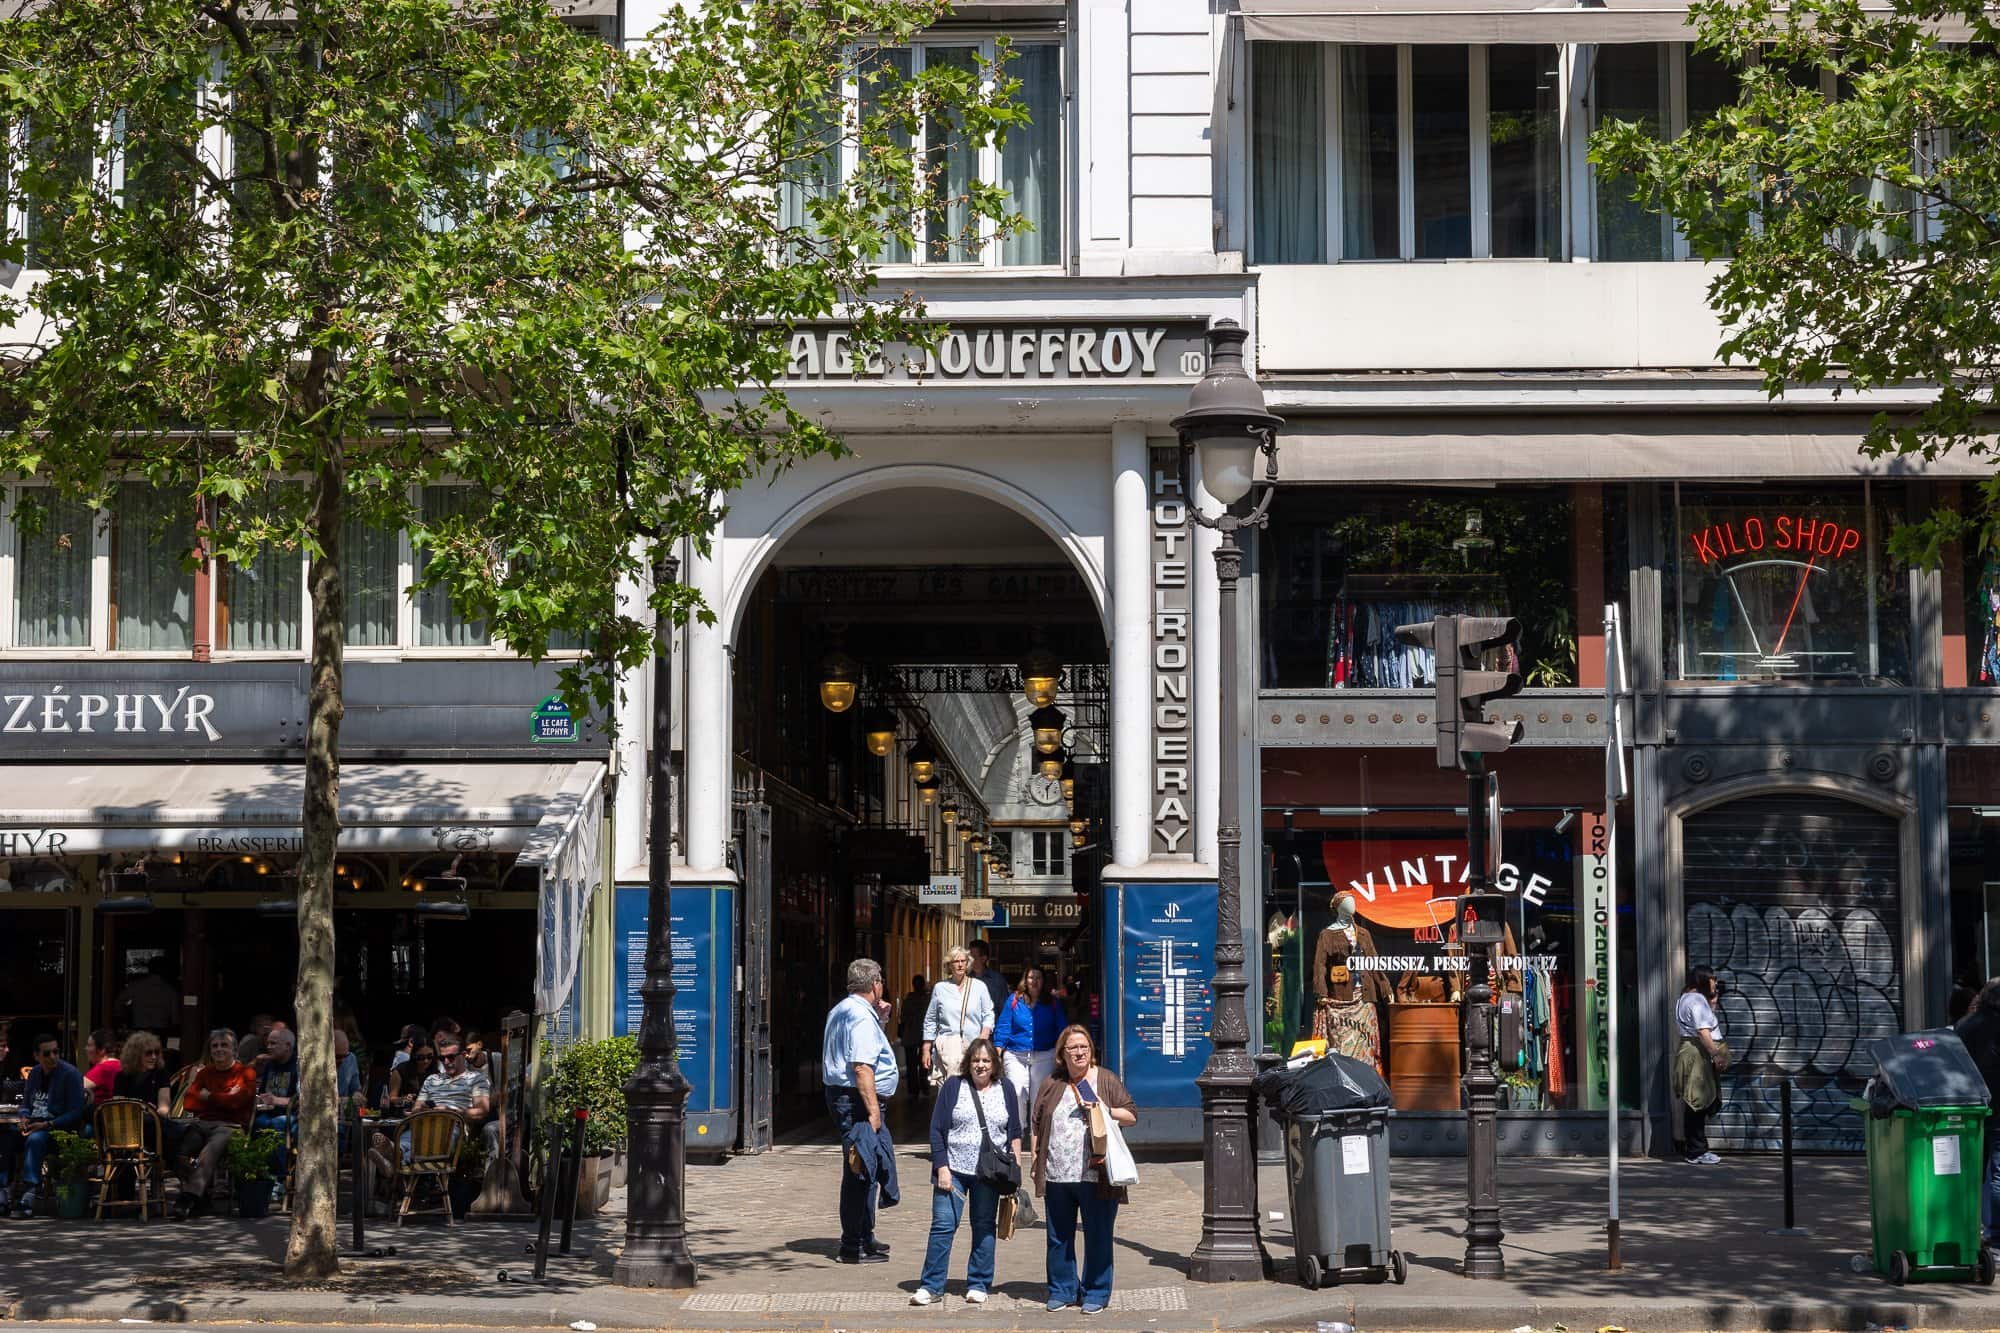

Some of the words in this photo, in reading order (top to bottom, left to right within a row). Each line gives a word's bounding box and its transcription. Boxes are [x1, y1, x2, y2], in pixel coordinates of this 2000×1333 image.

[1185, 355, 1200, 373] 10
[1155, 470, 1186, 614] HOTEL
[1691, 516, 1765, 565] KILO
[1776, 515, 1860, 559] SHOP
[933, 667, 972, 691] THE
[984, 667, 1108, 691] GALRIES
[3, 685, 223, 741] ZÉPHYR
[541, 719, 550, 727] LE
[542, 727, 569, 736] ZEPHYR
[1154, 614, 1189, 852] RONCERAY
[1591, 812, 1606, 880] TOKYO
[1005, 902, 1038, 917] ÔTEL
[1415, 926, 1439, 941] KILO
[1594, 898, 1608, 998] LONDRES
[1346, 956, 1429, 973] CHOISISSEZ,
[1597, 1012, 1609, 1096] PARIS
